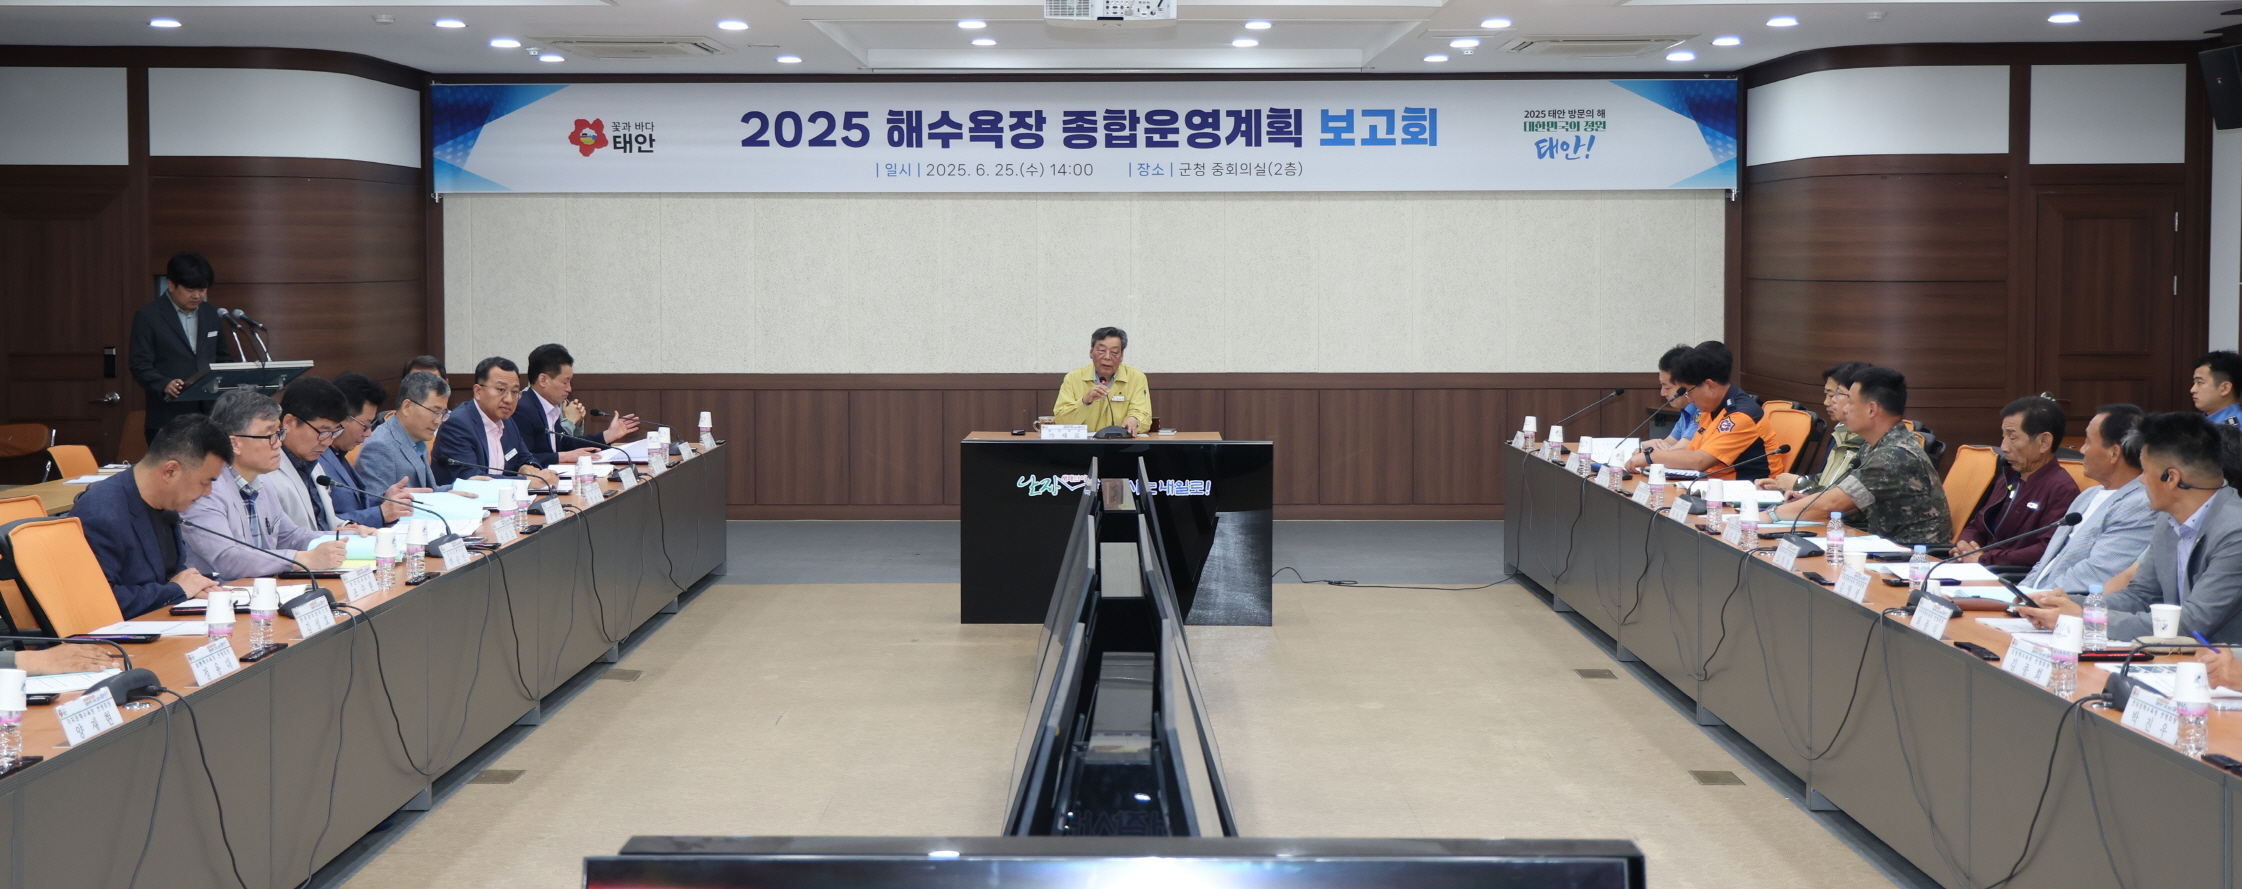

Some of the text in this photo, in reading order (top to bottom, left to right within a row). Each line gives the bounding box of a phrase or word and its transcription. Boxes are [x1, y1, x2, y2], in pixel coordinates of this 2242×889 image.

[1524, 109, 1605, 119] 2025 태안 방문의 해
[611, 122, 655, 132] 꽃과 바다
[741, 107, 1438, 149] 2025 해수욕장 종합운영계획 보고회
[1524, 121, 1606, 132] 대한민국의 정원
[613, 134, 656, 153] 태안
[1534, 135, 1596, 160] 태안!
[885, 162, 1094, 178] 일시 2025. 6. 25.(수) 14:00
[1137, 162, 1303, 177] 장소 군청 중회의실(2층)
[1159, 479, 1212, 496] 내일로!
